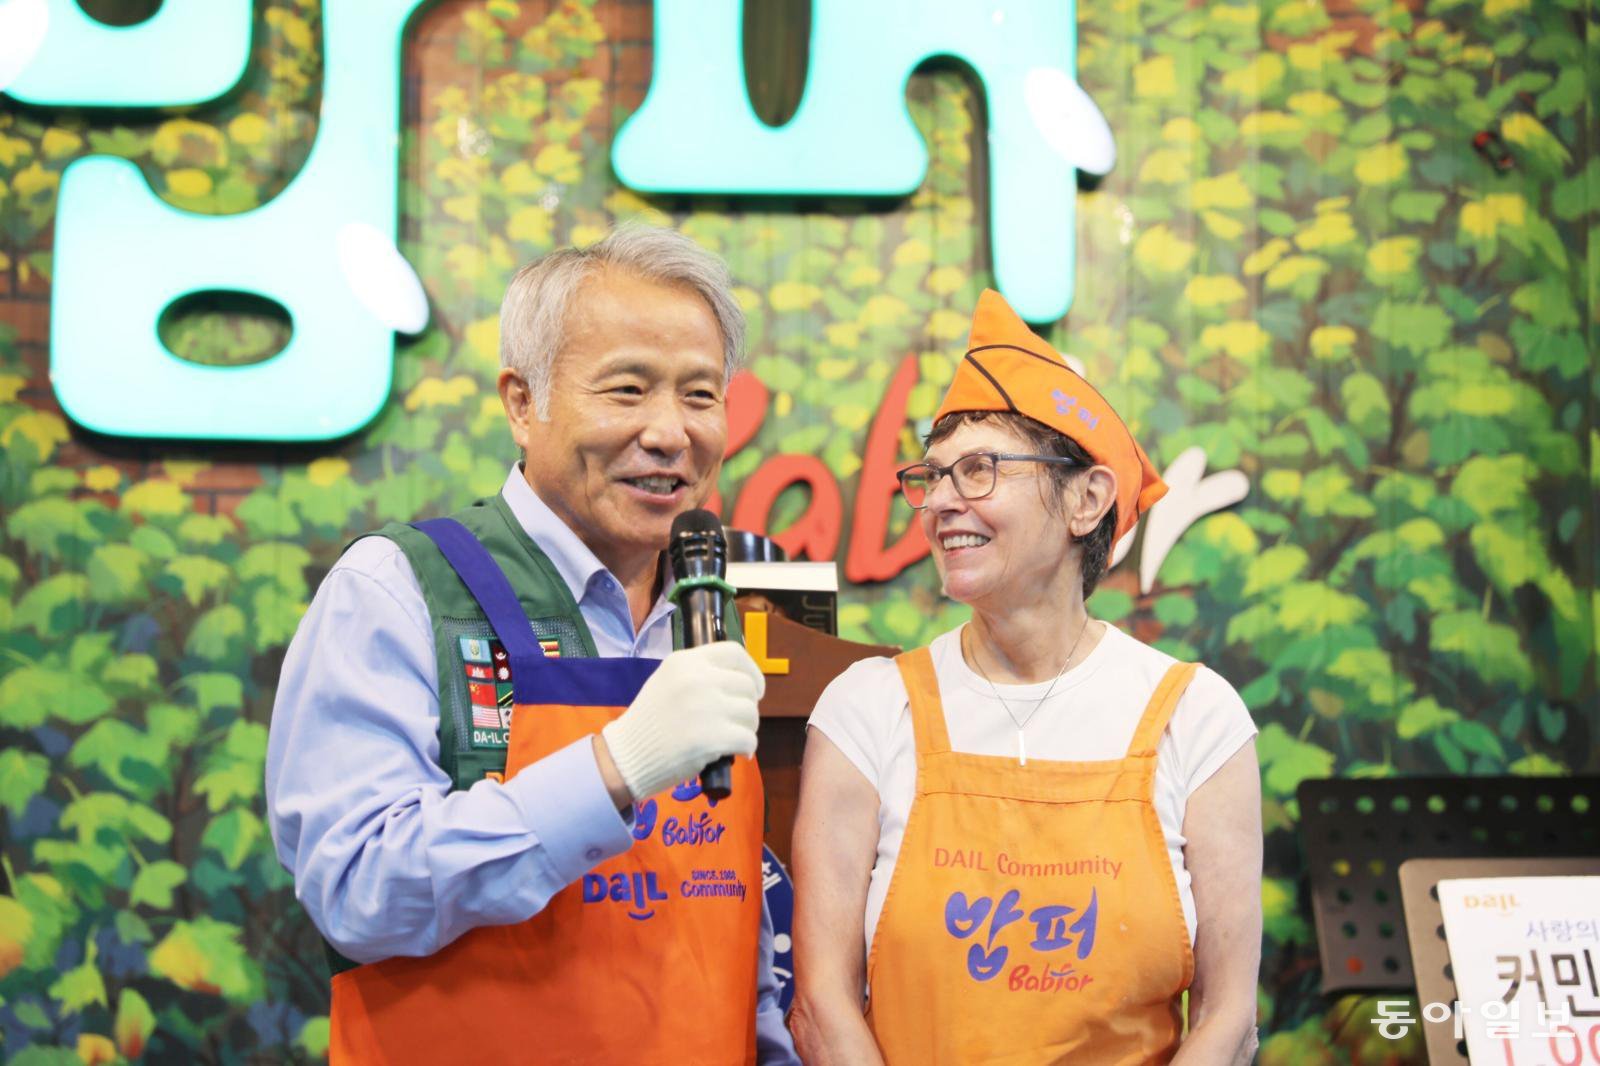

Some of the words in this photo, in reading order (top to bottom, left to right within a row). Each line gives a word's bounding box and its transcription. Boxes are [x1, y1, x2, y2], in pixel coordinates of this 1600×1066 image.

[473, 731, 502, 744] DA-IL
[933, 847, 988, 872] DAIL
[997, 852, 1123, 880] Community
[681, 879, 747, 902] Community
